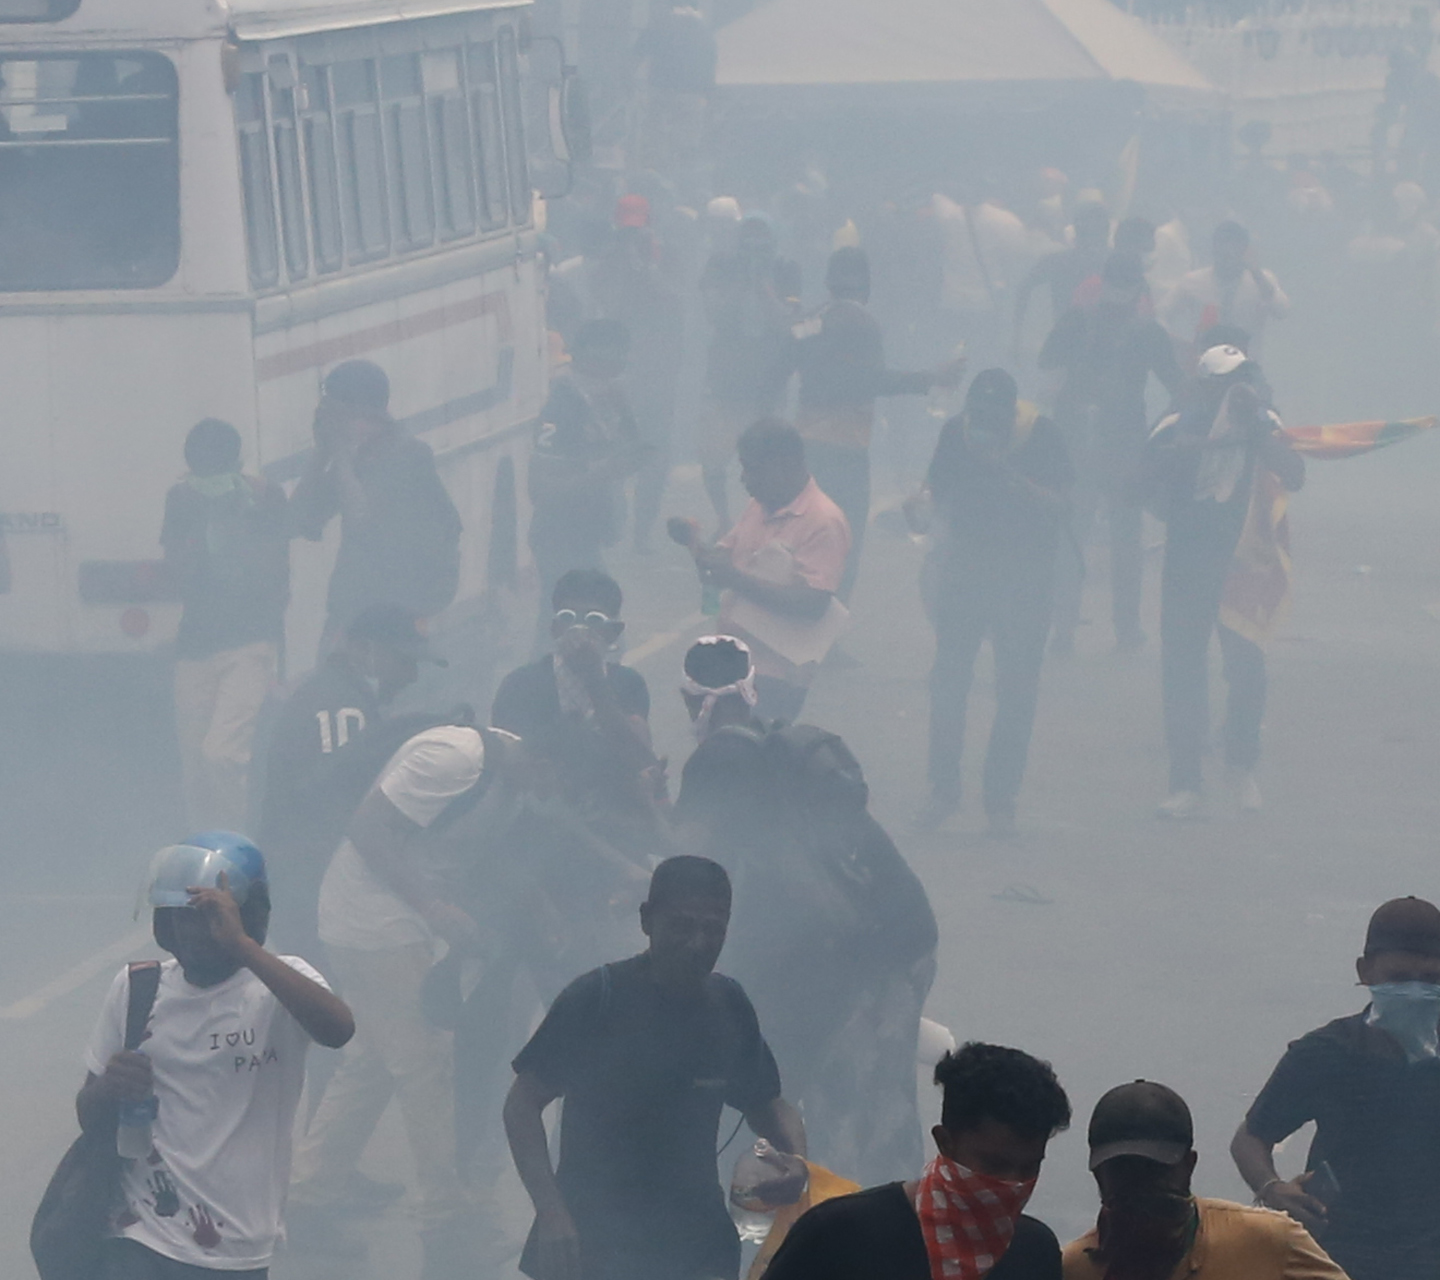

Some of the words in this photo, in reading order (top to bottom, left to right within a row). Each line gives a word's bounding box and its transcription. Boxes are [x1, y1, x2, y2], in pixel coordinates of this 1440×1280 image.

[316, 707, 365, 753] 10
[210, 1033, 220, 1050] I
[243, 1028, 255, 1045] U
[235, 1047, 278, 1072] PAA
